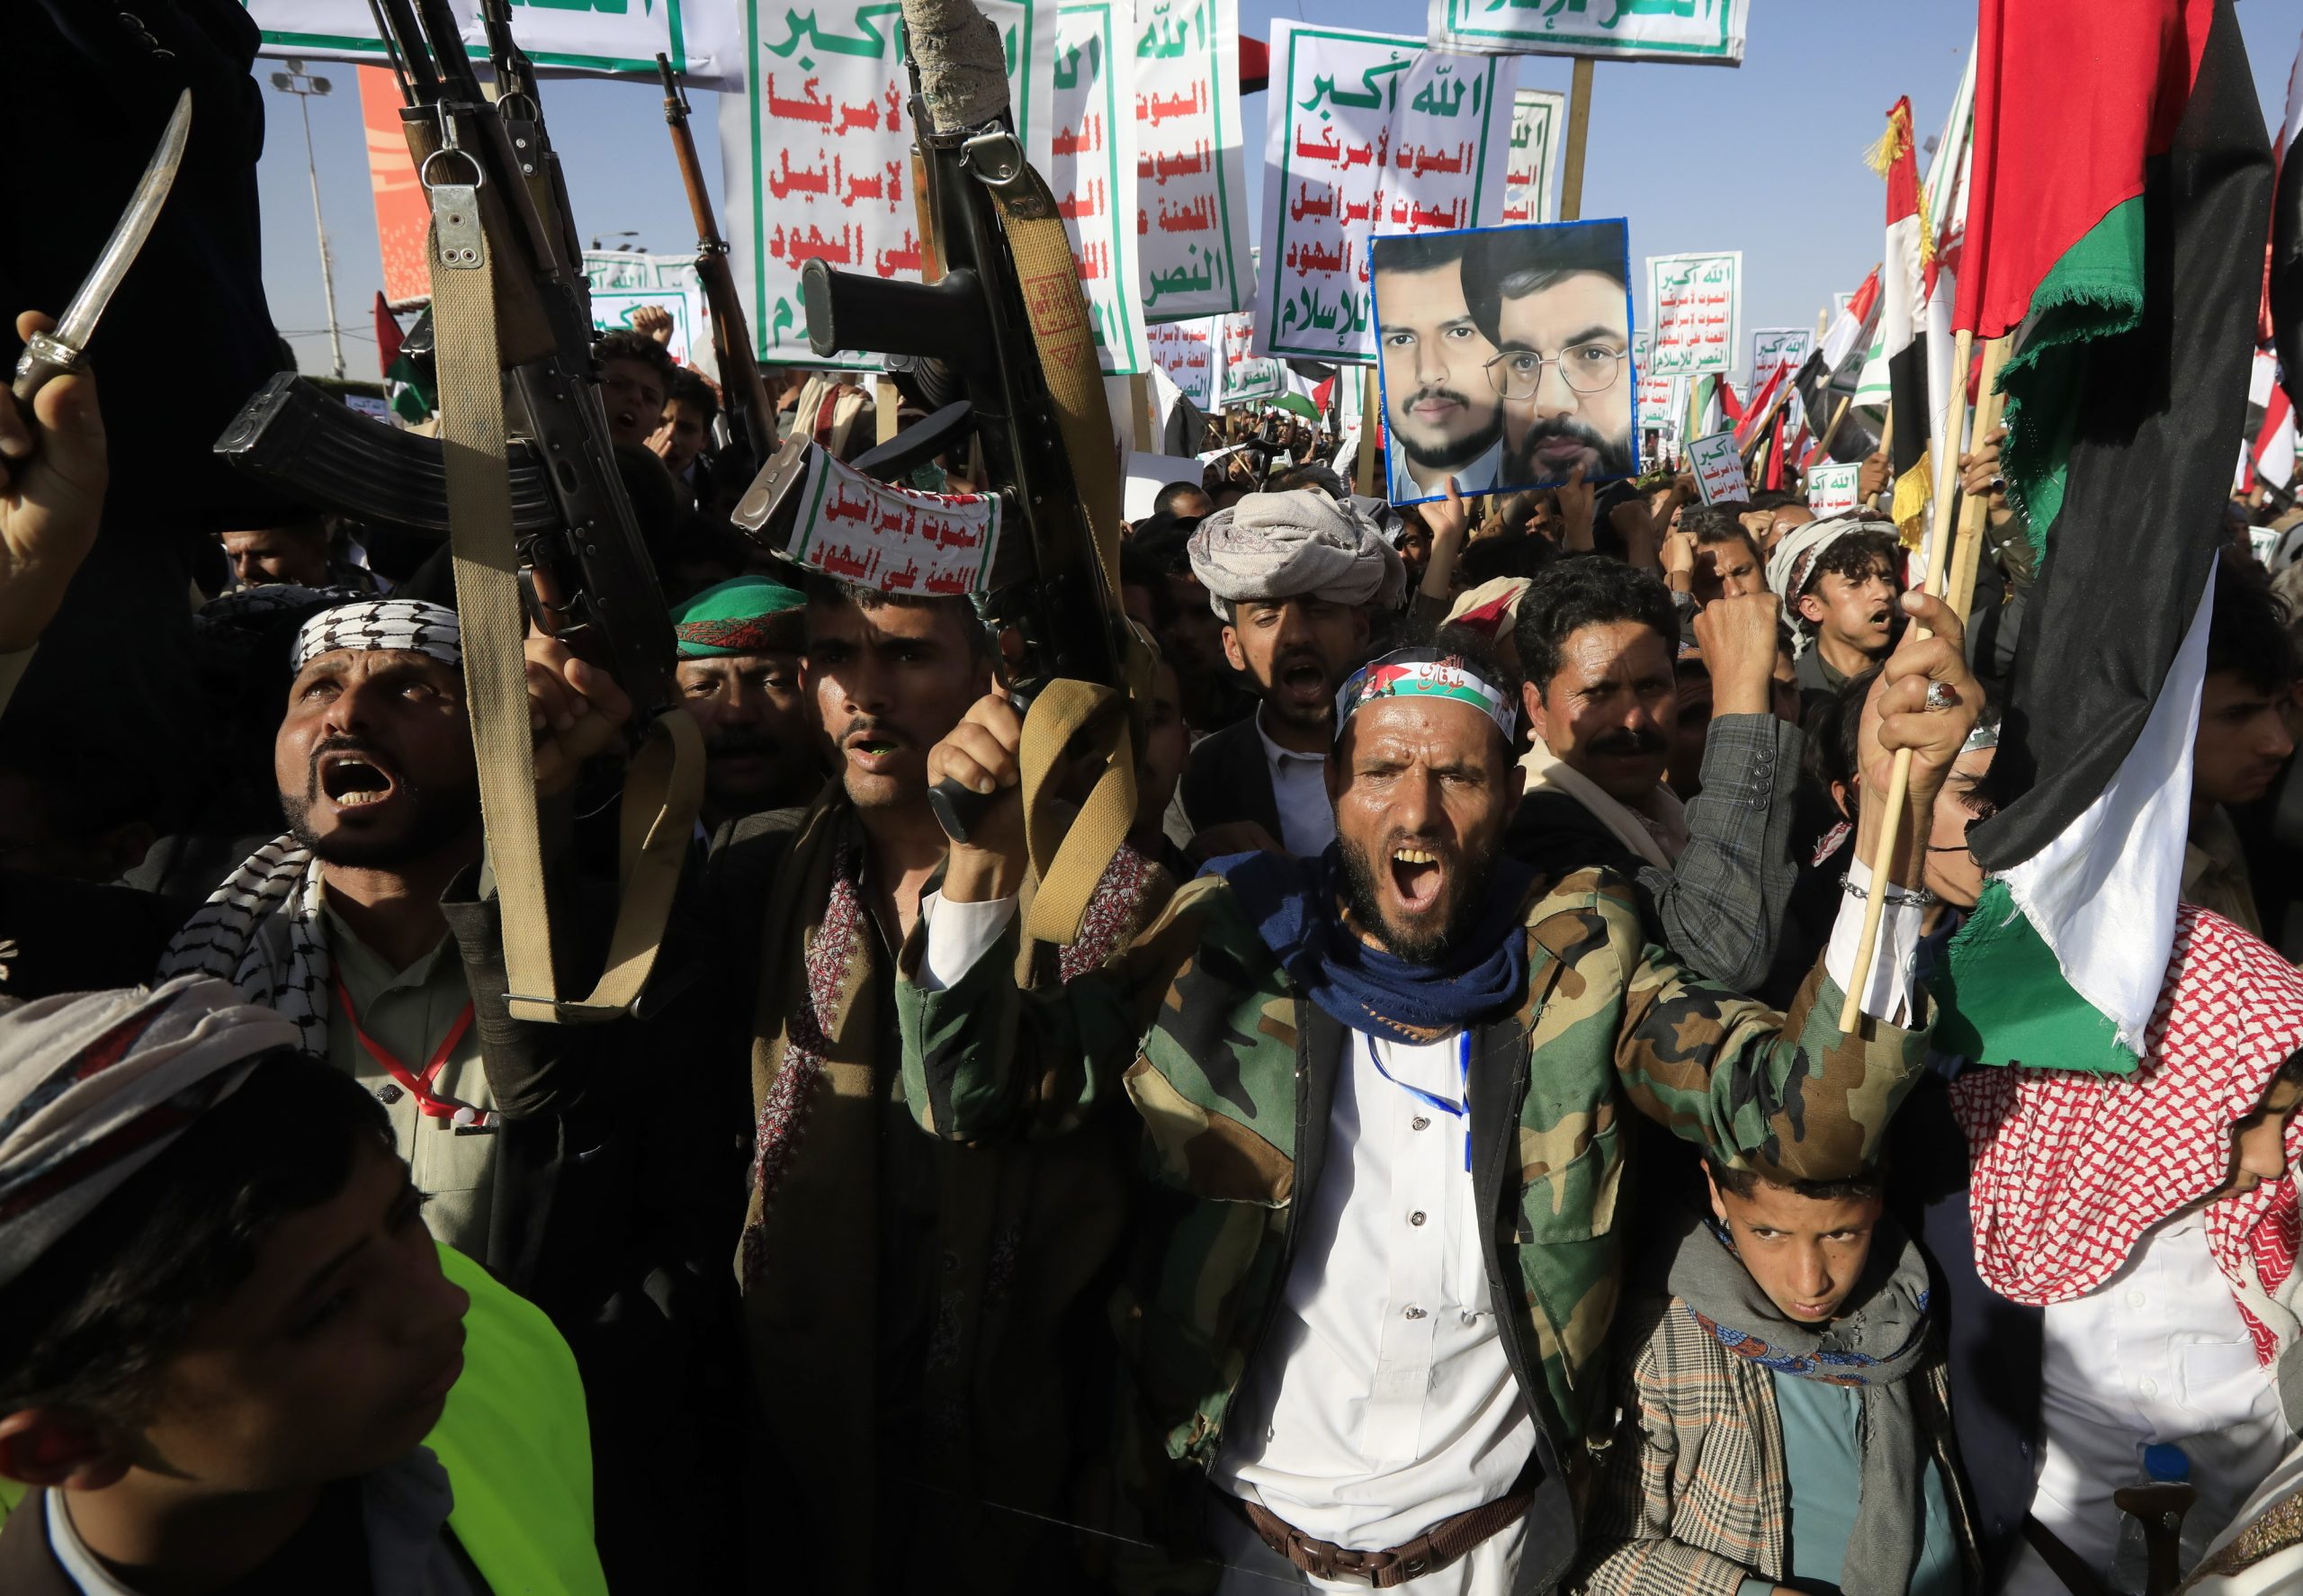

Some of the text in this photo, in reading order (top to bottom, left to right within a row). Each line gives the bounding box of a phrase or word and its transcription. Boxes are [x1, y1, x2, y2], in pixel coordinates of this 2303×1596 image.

[1135, 77, 1206, 128] الموت
[1296, 51, 1482, 121] الله أكبر
[1137, 137, 1211, 186] الموت
[1396, 140, 1474, 179] الموت
[1159, 193, 1216, 233] اللعنة
[1391, 197, 1467, 233] الموت
[1142, 243, 1224, 308] النصر
[1286, 239, 1352, 280] اليهود
[1660, 263, 1701, 291] أكبر
[1282, 286, 1370, 347] للإسلام
[1698, 291, 1729, 306] الموت
[1698, 311, 1728, 327] الموت
[1705, 330, 1728, 343] اللعنة
[1831, 471, 1855, 489] الله
[922, 514, 985, 551] الموت
[881, 555, 919, 591] على
[925, 560, 977, 595] اللعنة
[1417, 666, 1465, 694] طوفان
